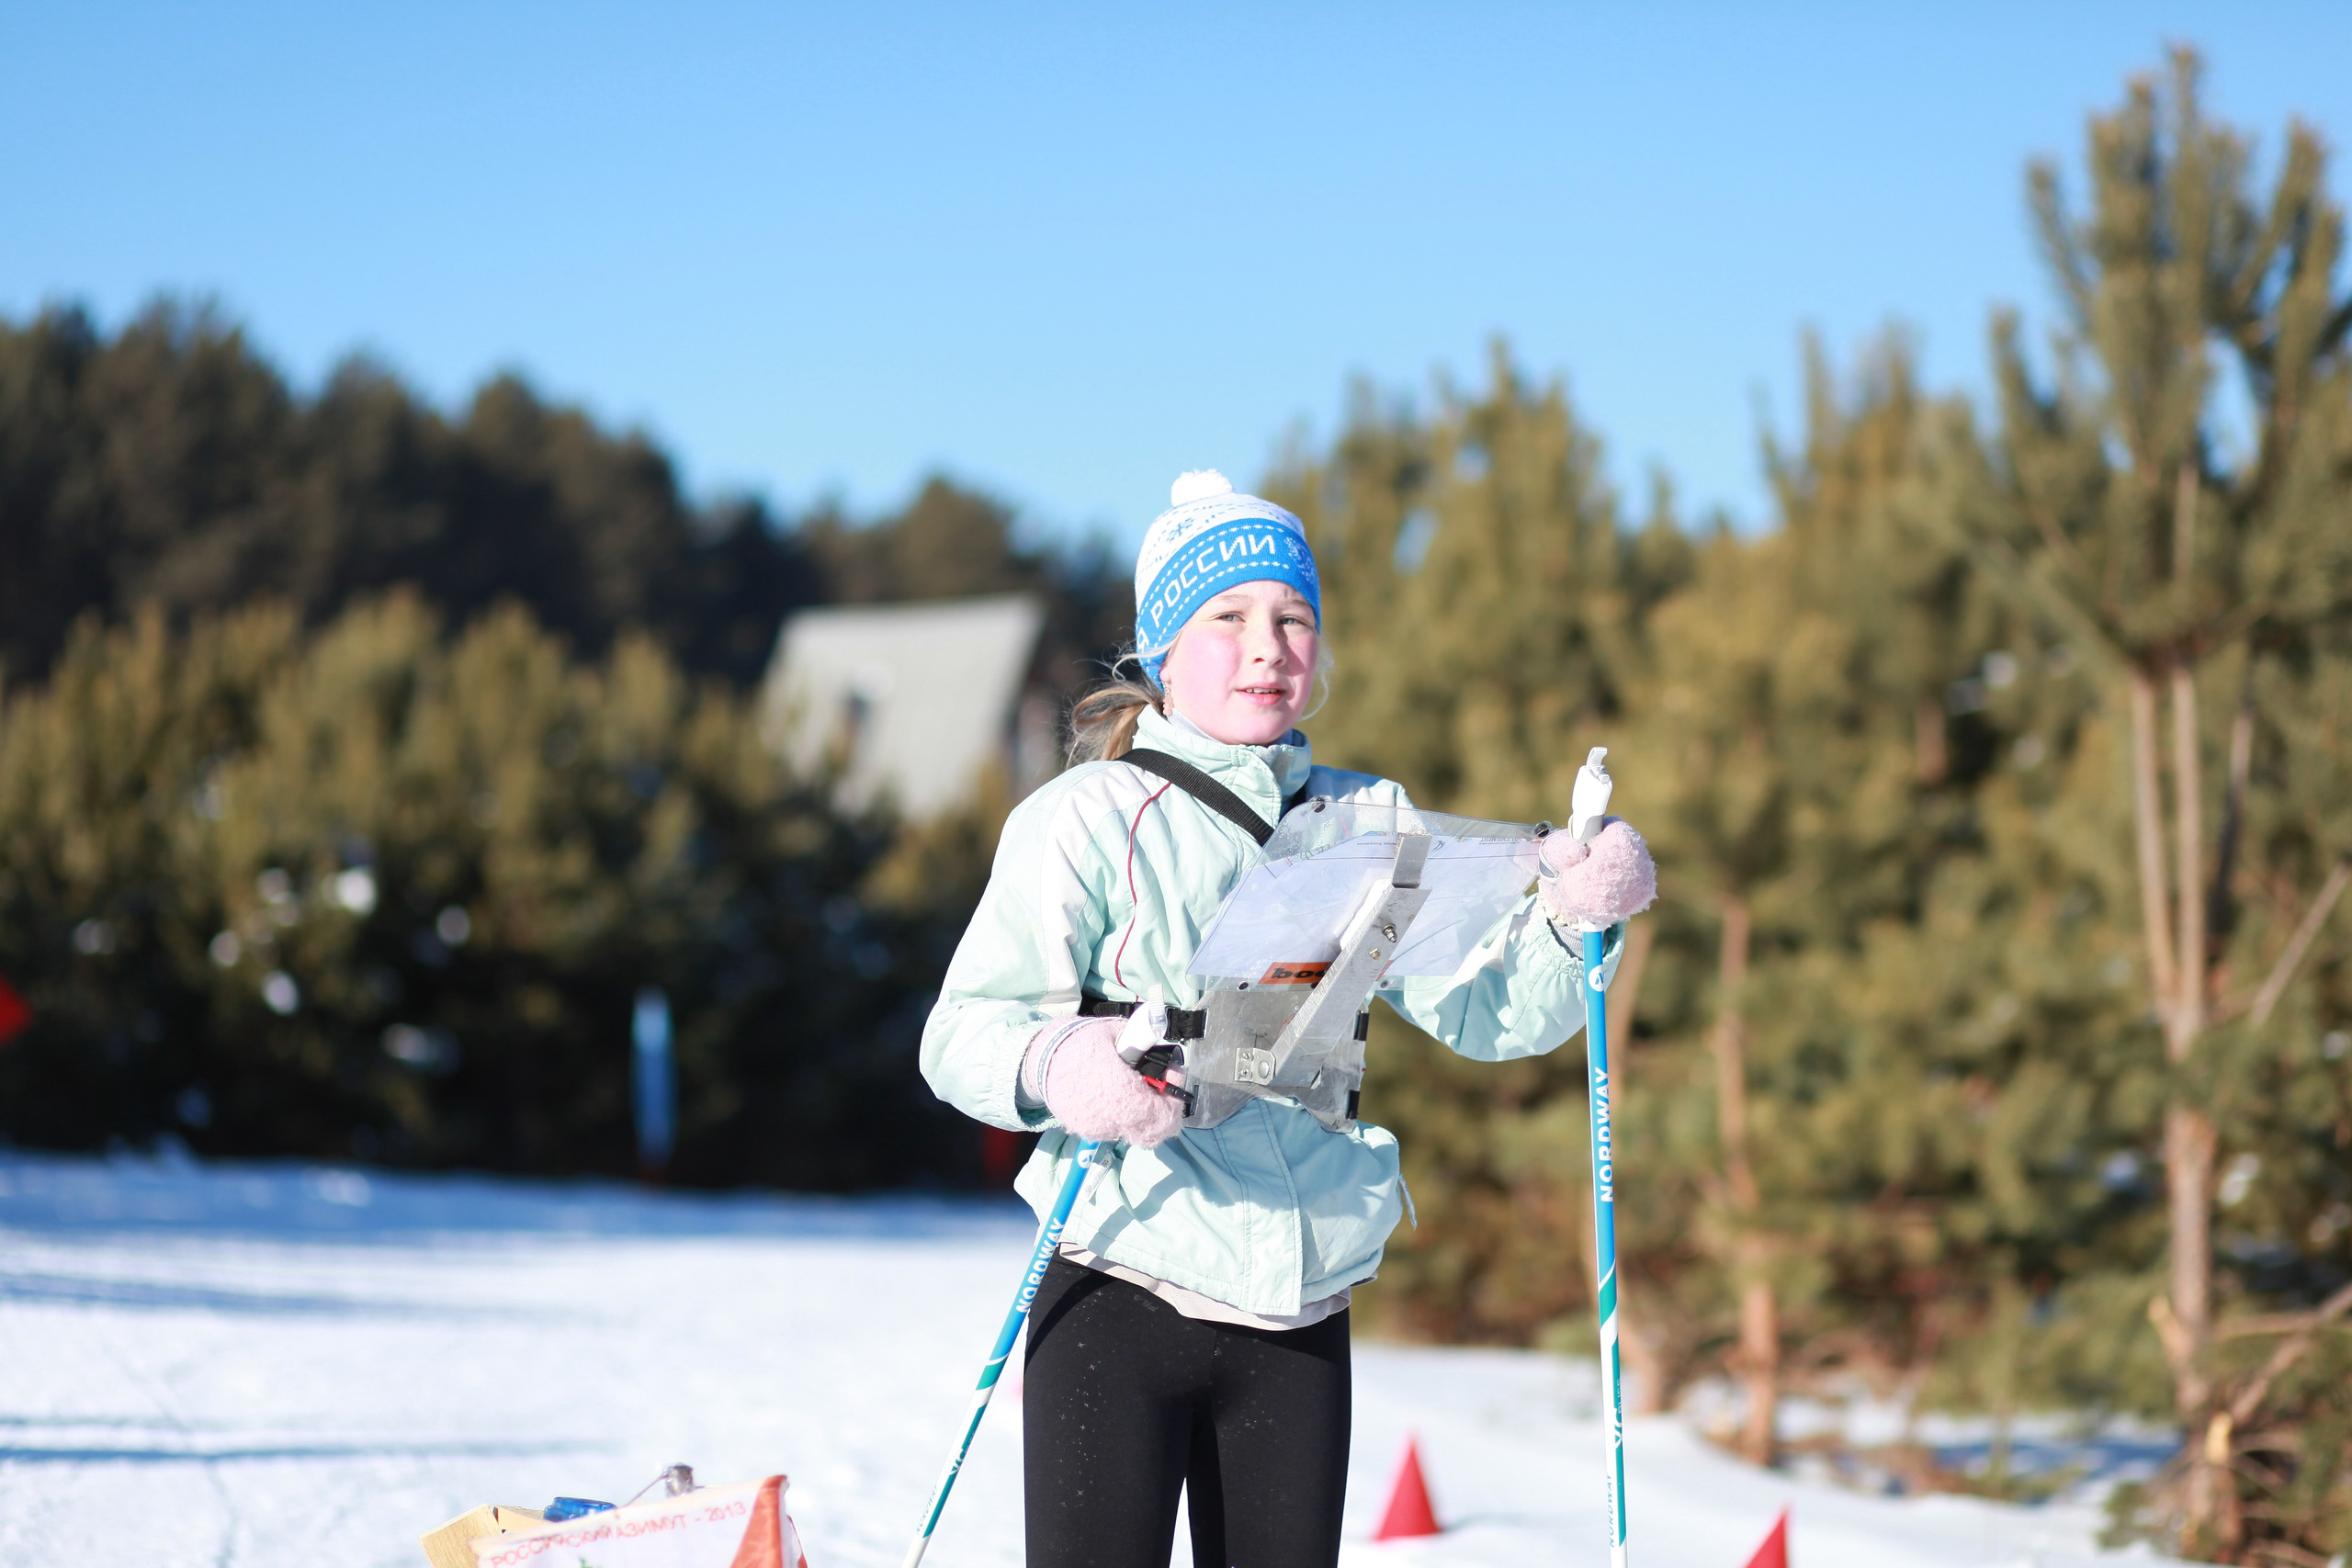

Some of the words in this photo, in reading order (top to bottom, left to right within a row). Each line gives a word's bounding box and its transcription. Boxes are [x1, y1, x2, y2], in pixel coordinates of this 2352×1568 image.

[1150, 534, 1276, 629] РОССИИ
[1594, 1066, 1614, 1202] NORDWAY
[1015, 1217, 1066, 1314] NORDWAY
[615, 1514, 688, 1540] АЗИМУТ
[704, 1501, 747, 1522] 2013
[1608, 1473, 1616, 1548] NORDWAY
